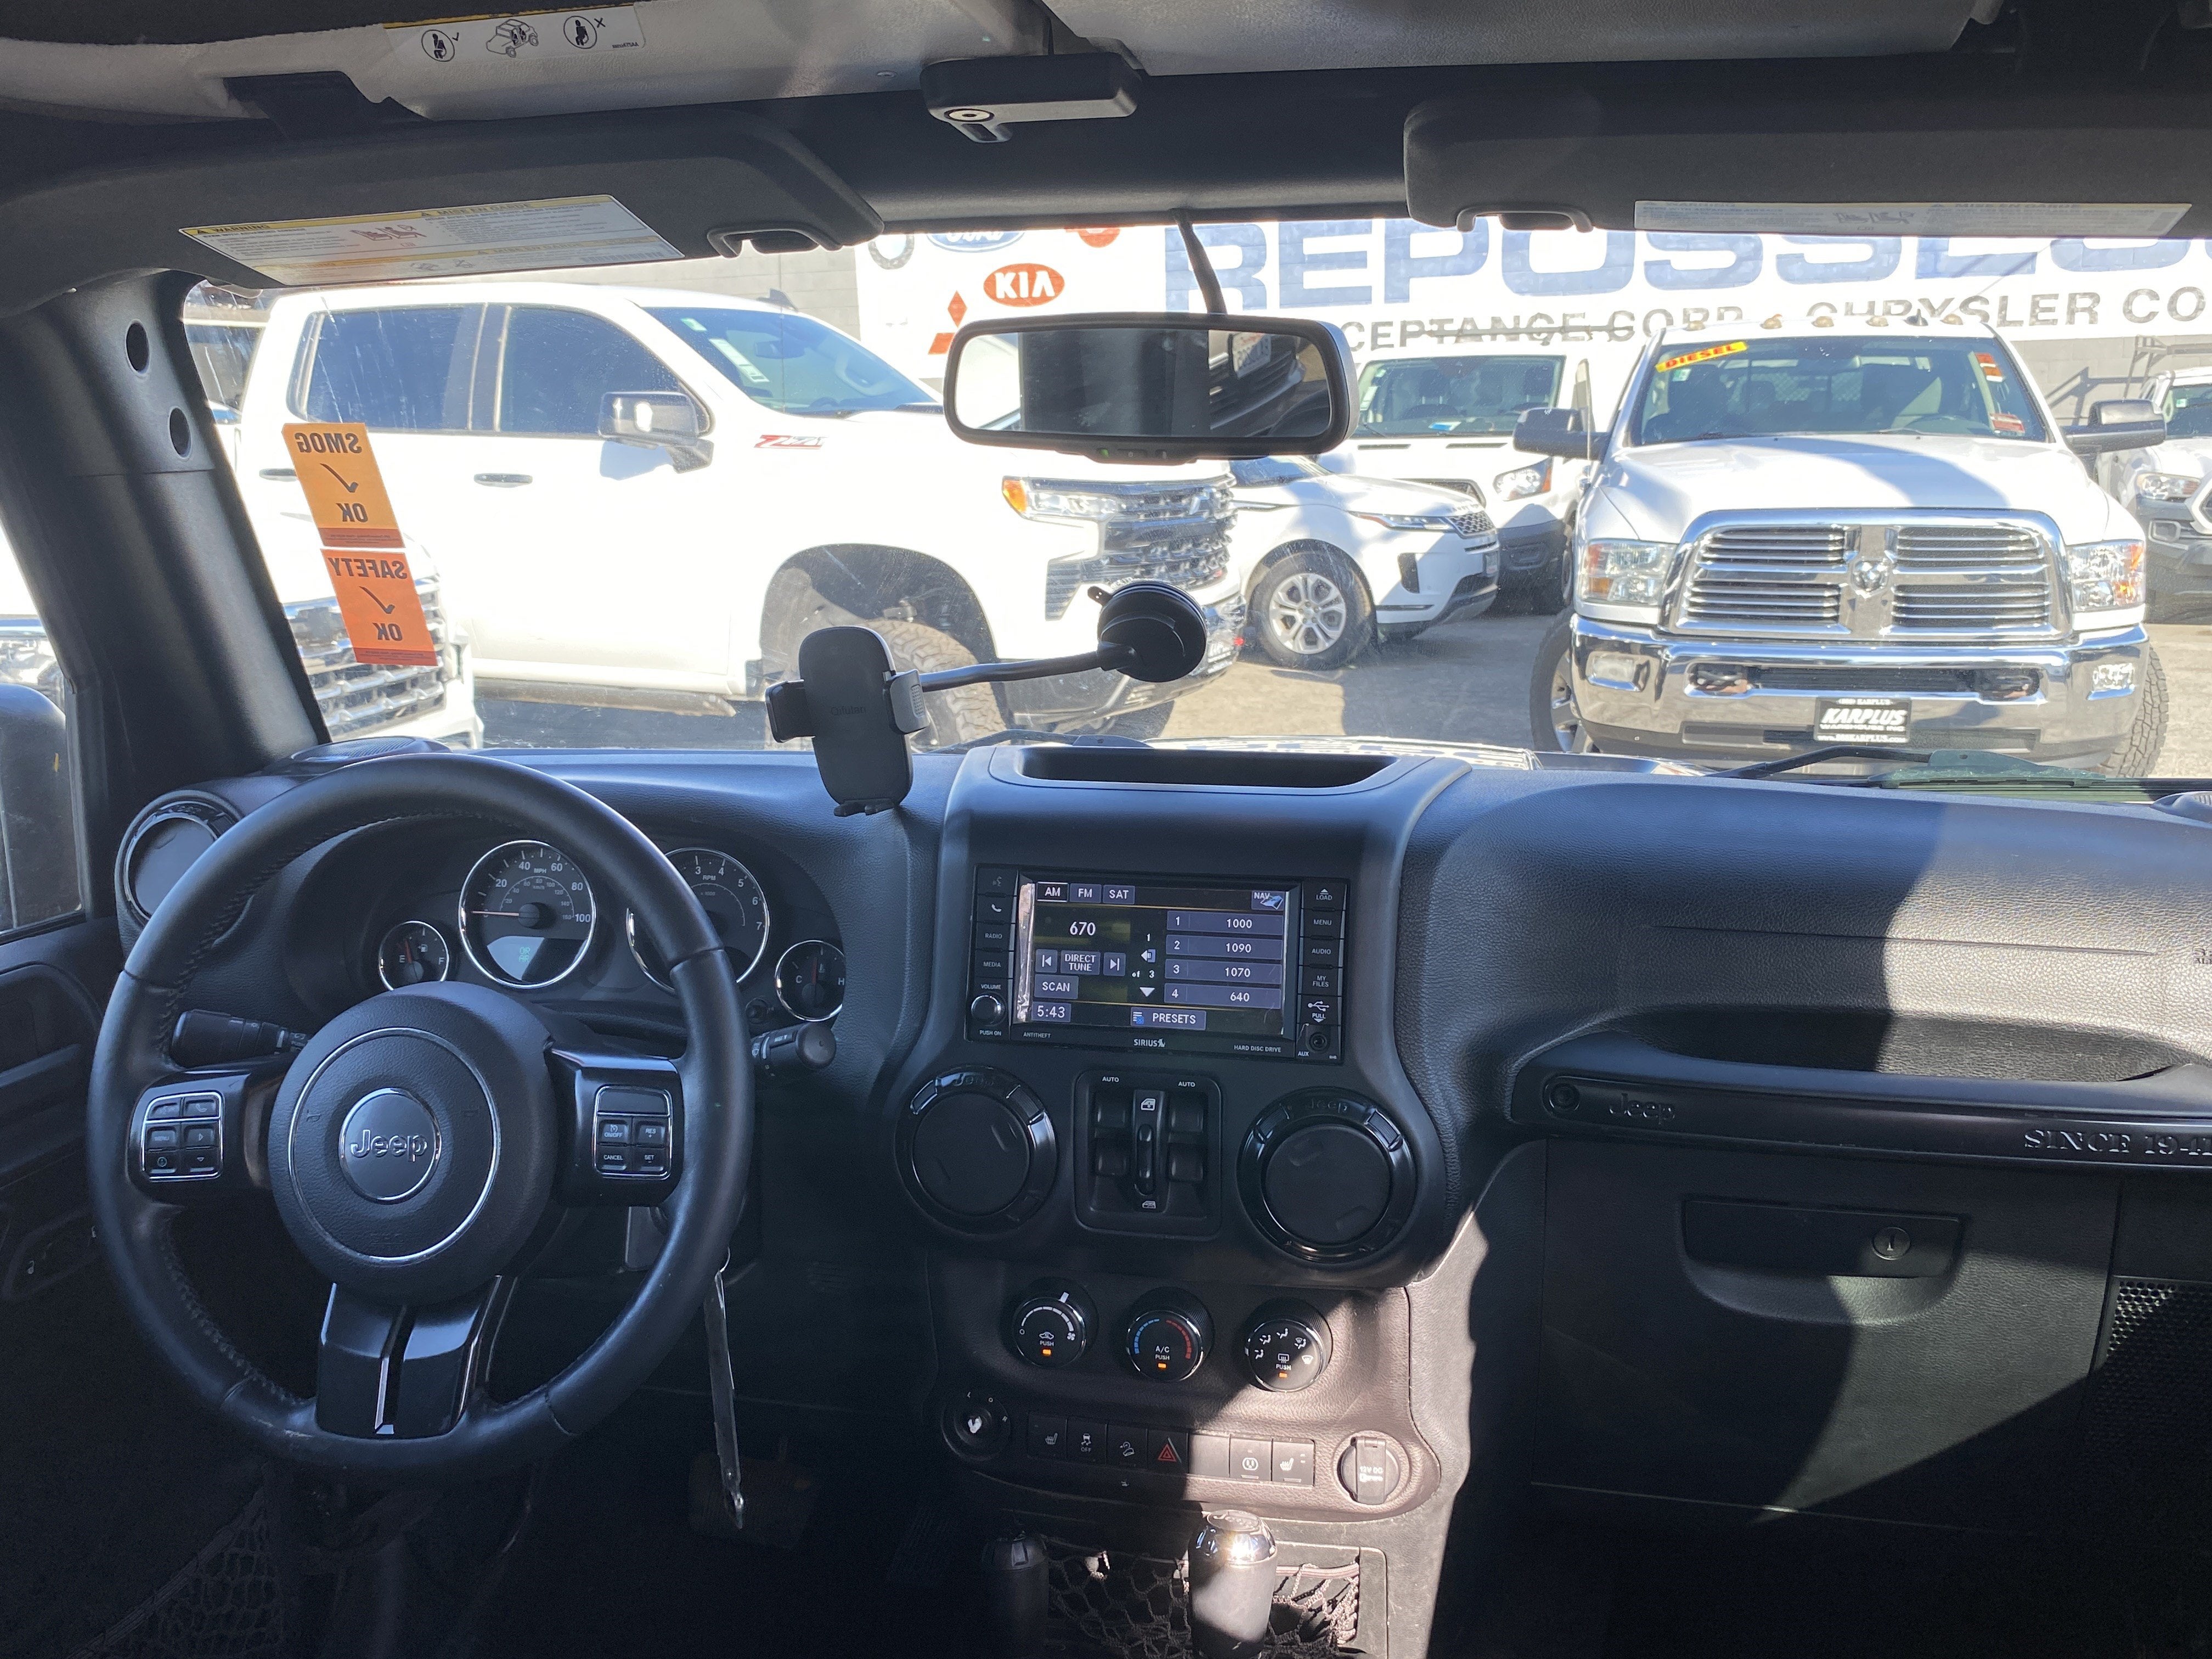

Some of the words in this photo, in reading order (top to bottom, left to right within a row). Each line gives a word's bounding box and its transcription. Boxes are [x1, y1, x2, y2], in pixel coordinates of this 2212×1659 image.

[212, 224, 270, 233] WARNING
[994, 270, 1055, 299] KIA
[1341, 312, 1585, 352] CEPTANCE
[1666, 344, 1738, 369] DIESEL
[1820, 707, 1908, 726] KARPLUS
[518, 861, 531, 870] 40
[551, 863, 563, 872] 60
[695, 866, 701, 874] 3
[718, 867, 724, 876] 4
[495, 879, 507, 888] 20
[571, 882, 584, 891] 80
[738, 879, 744, 887] 5
[1045, 887, 1061, 897] AM
[1078, 888, 1093, 898] FM
[1109, 890, 1129, 900] SAT
[752, 896, 759, 905] 6
[575, 913, 591, 923] 100
[1175, 916, 1181, 926] 1
[1226, 918, 1252, 929] 1000
[756, 922, 763, 930] 7
[1069, 922, 1096, 936] 670
[1173, 940, 1181, 950] 2
[1226, 943, 1252, 953] 1090
[399, 955, 405, 963] E
[439, 957, 445, 965] F
[1065, 953, 1096, 963] DIRECT
[1069, 963, 1093, 972] TUNE
[1173, 964, 1180, 974] 3
[1225, 967, 1251, 978] 1070
[1149, 970, 1155, 978] 3
[795, 975, 803, 984] C
[838, 977, 845, 986] H
[1042, 981, 1070, 992] SCAN
[1171, 989, 1179, 998] 4
[1230, 992, 1250, 1002] 640
[1037, 1005, 1065, 1018] 5:43
[1152, 1013, 1197, 1024] PRESETS
[1133, 1039, 1158, 1047] SIRIUS
[350, 1129, 428, 1163] Jeep
[2024, 1129, 2131, 1153] SINCE
[1155, 1345, 1170, 1353] A/C
